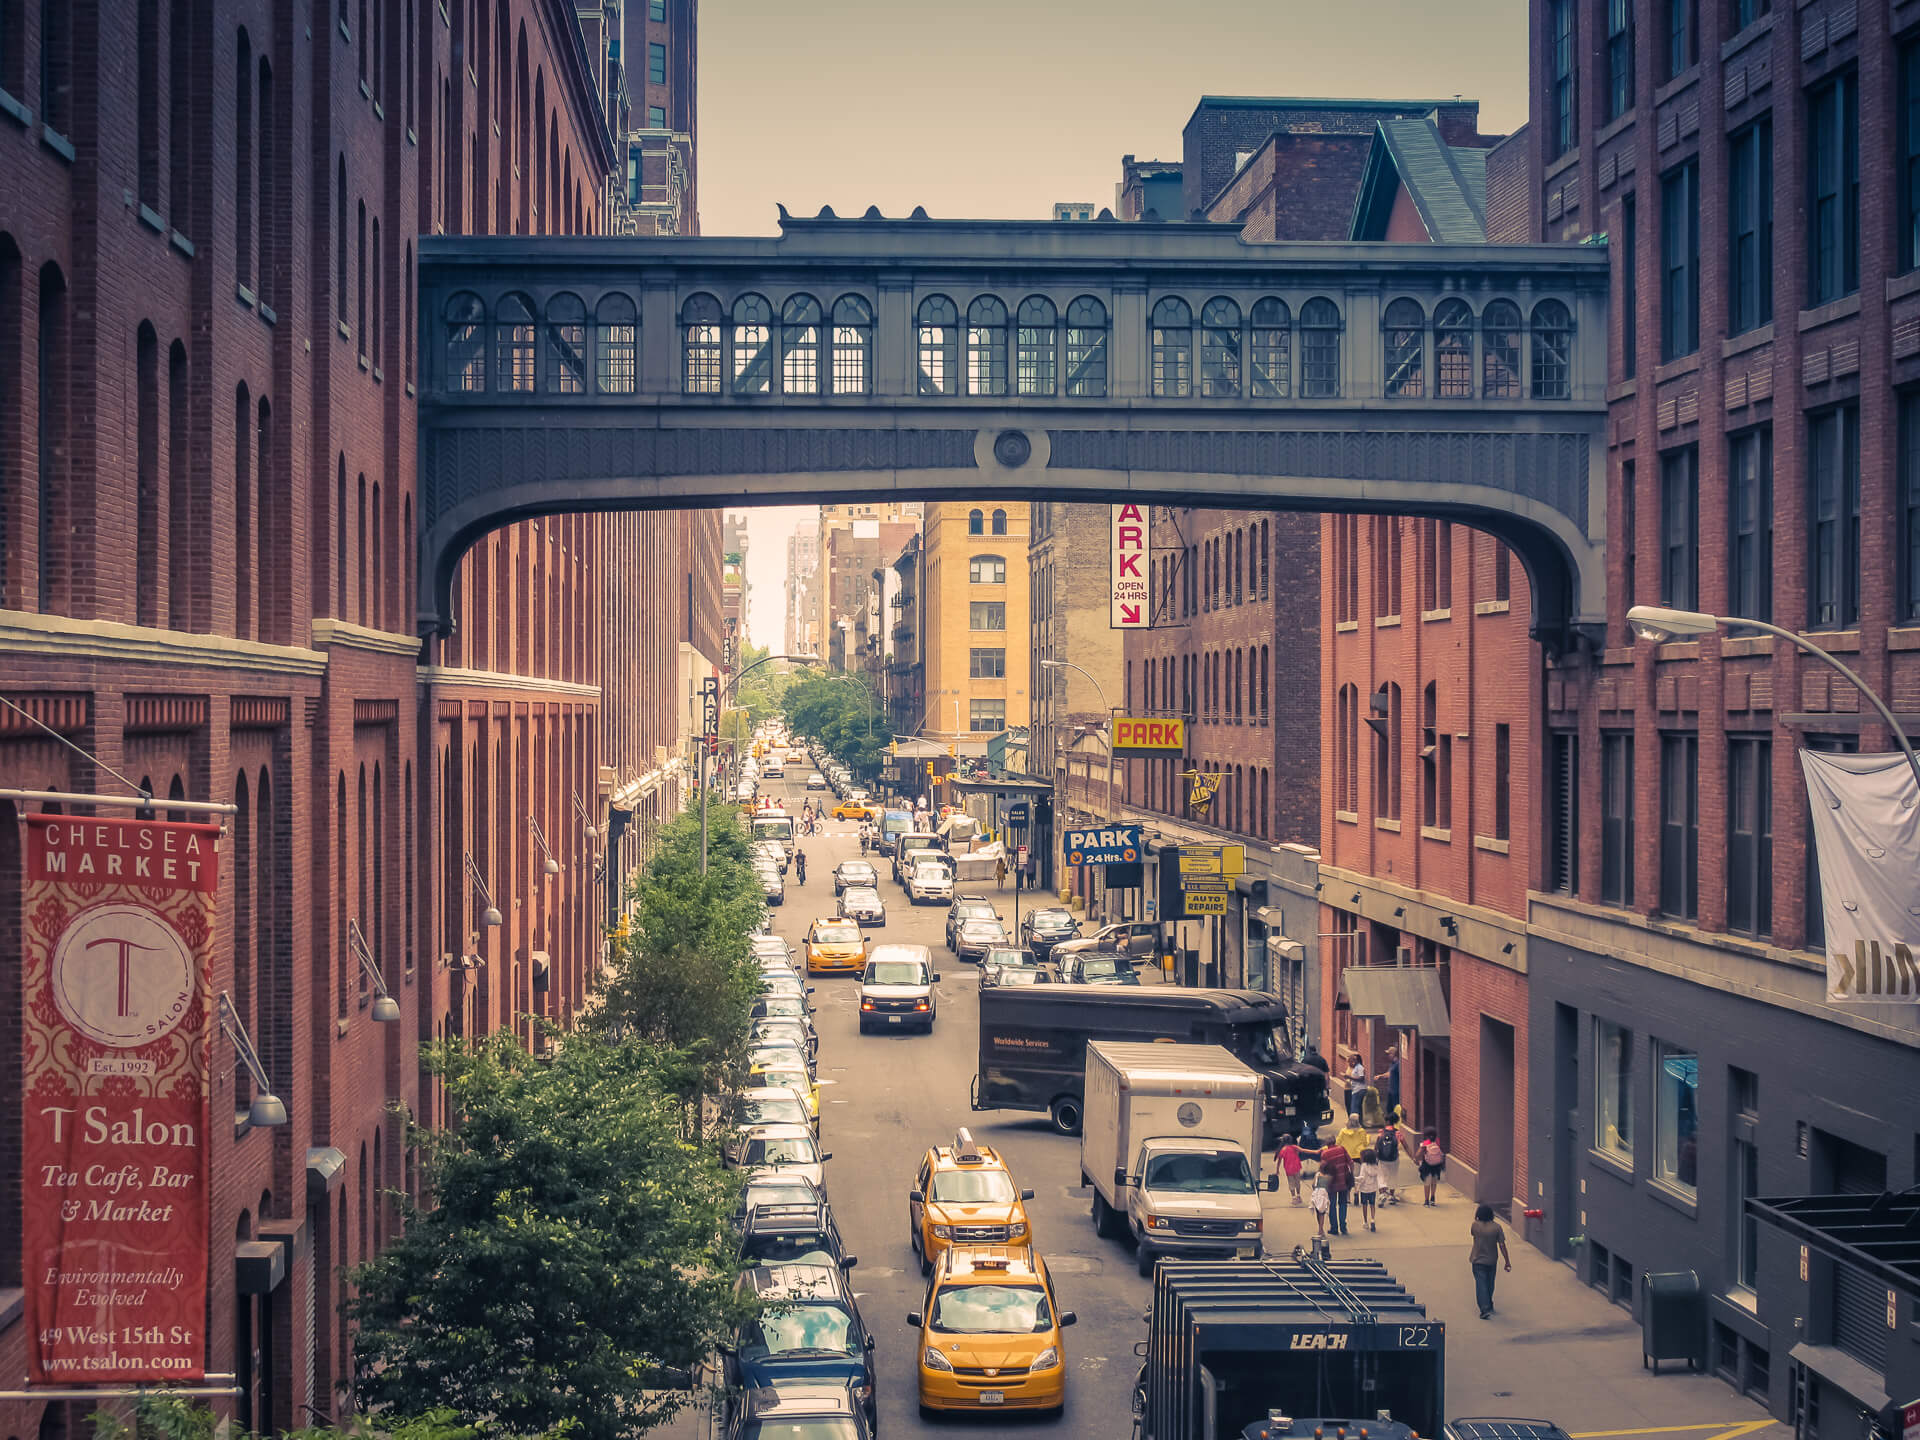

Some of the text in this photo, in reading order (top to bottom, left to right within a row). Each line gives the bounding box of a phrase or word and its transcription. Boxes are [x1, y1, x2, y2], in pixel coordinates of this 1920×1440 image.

[1117, 504, 1143, 577] ARK
[1114, 592, 1148, 600] 24 HRS
[1117, 582, 1144, 591] OPEN
[705, 680, 717, 734] PARK
[1117, 723, 1180, 745] PARK
[46, 824, 200, 855] CHELSEA
[1070, 829, 1133, 849] PARK
[46, 852, 200, 882] MARKET
[1086, 855, 1103, 863] 24
[1188, 903, 1225, 911] REPAIRS
[1193, 895, 1221, 903] AUTO
[145, 991, 189, 1035] SALON
[993, 1036, 1049, 1048] Worldwide Services
[93, 1060, 149, 1074] Est. 1992
[40, 1106, 195, 1147] T Salon
[41, 1164, 194, 1193] Tea Café, Bar
[60, 1200, 173, 1222] & Market
[44, 1267, 184, 1290] Environmentally
[73, 1288, 147, 1306] Evolved
[65, 1326, 117, 1345] West
[121, 1326, 164, 1345] 15th
[170, 1325, 193, 1345] St
[1290, 1333, 1348, 1350] LEACH
[42, 1351, 192, 1371] www.tsalon.com
